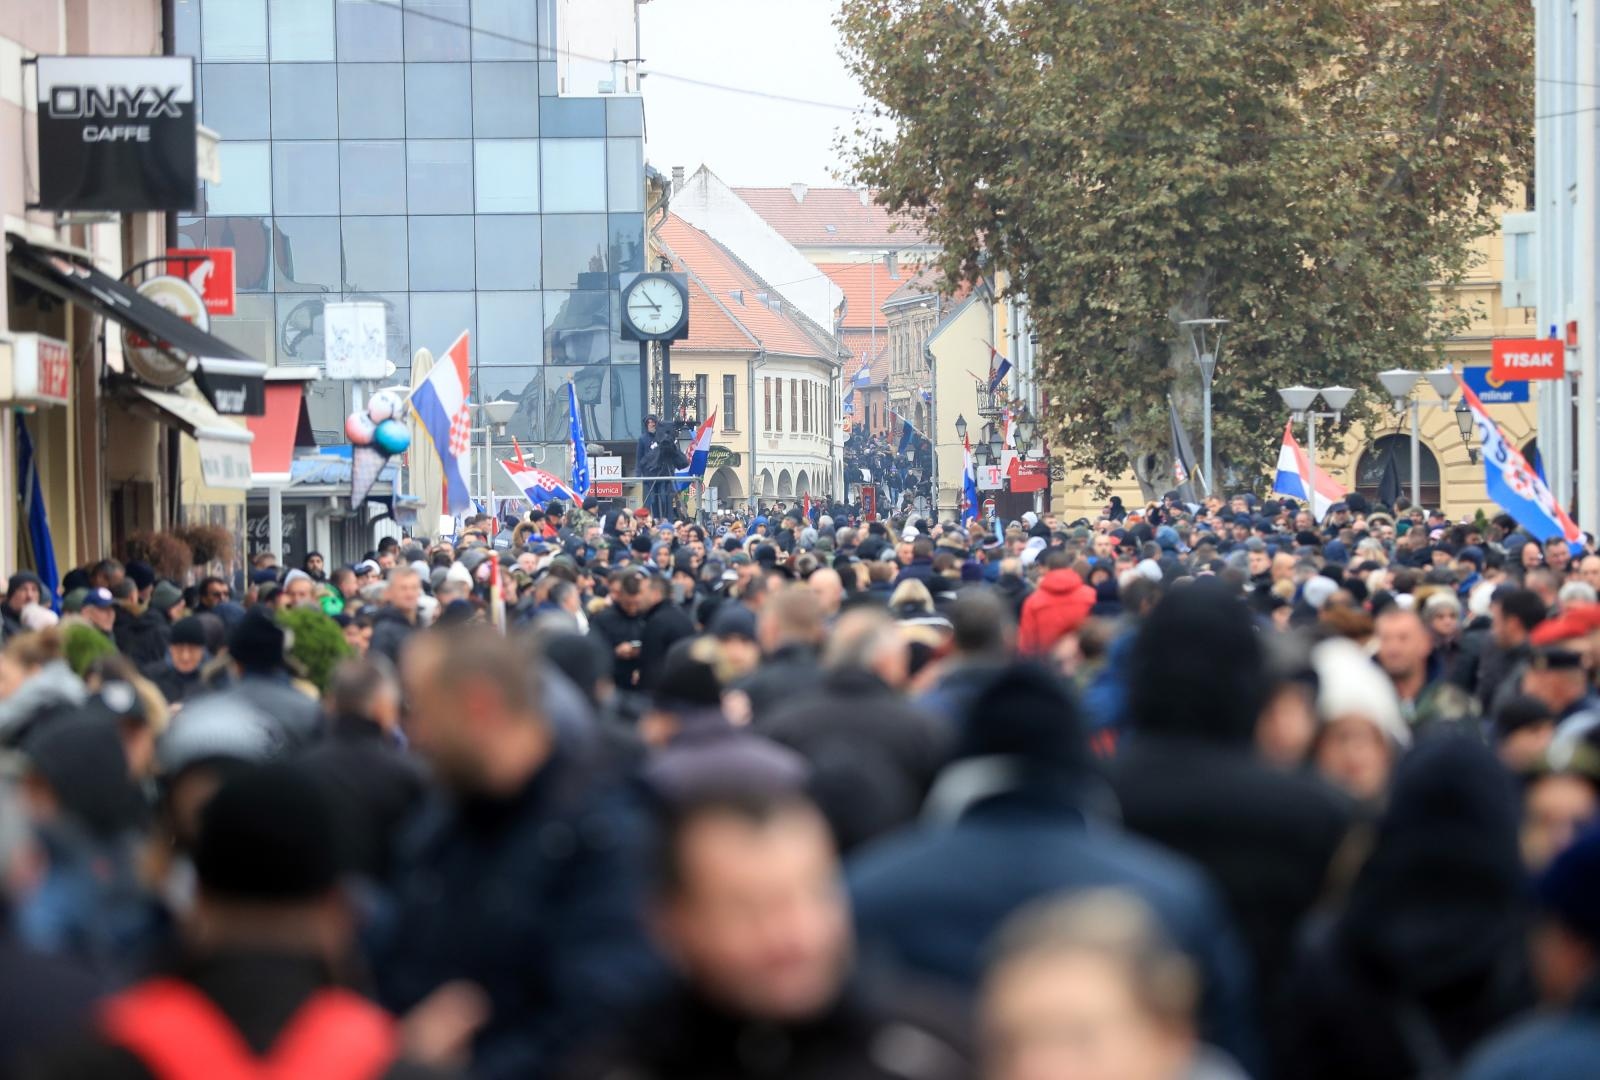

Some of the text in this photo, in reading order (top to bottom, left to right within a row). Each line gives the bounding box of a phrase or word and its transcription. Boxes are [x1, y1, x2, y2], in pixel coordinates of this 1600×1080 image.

[49, 85, 183, 118] ONYX
[82, 124, 151, 142] CAFFE
[1502, 353, 1554, 367] TISAK
[707, 450, 730, 460] ntique
[600, 465, 620, 475] PBZ
